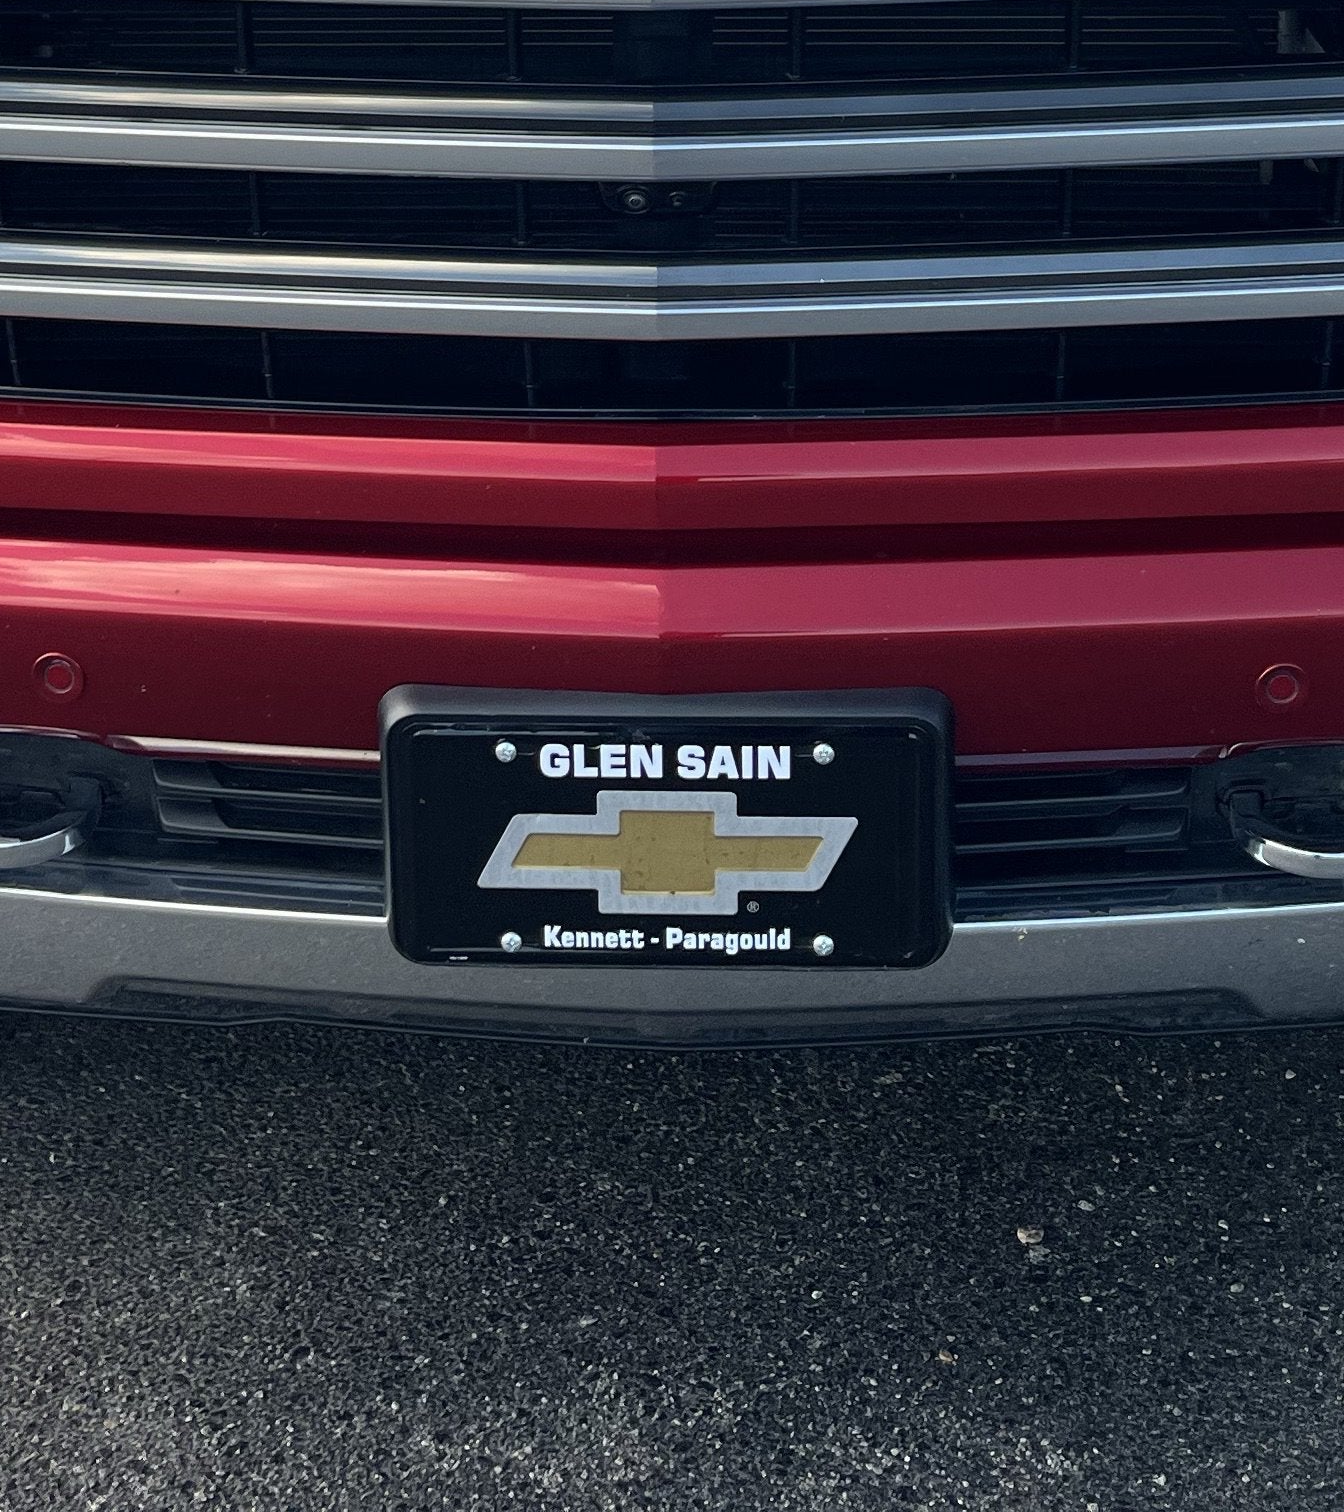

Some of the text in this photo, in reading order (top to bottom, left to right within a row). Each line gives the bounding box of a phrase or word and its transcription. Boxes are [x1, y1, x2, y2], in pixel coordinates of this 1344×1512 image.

[539, 743, 792, 780] GLEN SAIN
[543, 924, 646, 950] Kennett
[665, 926, 792, 955] Paragould
